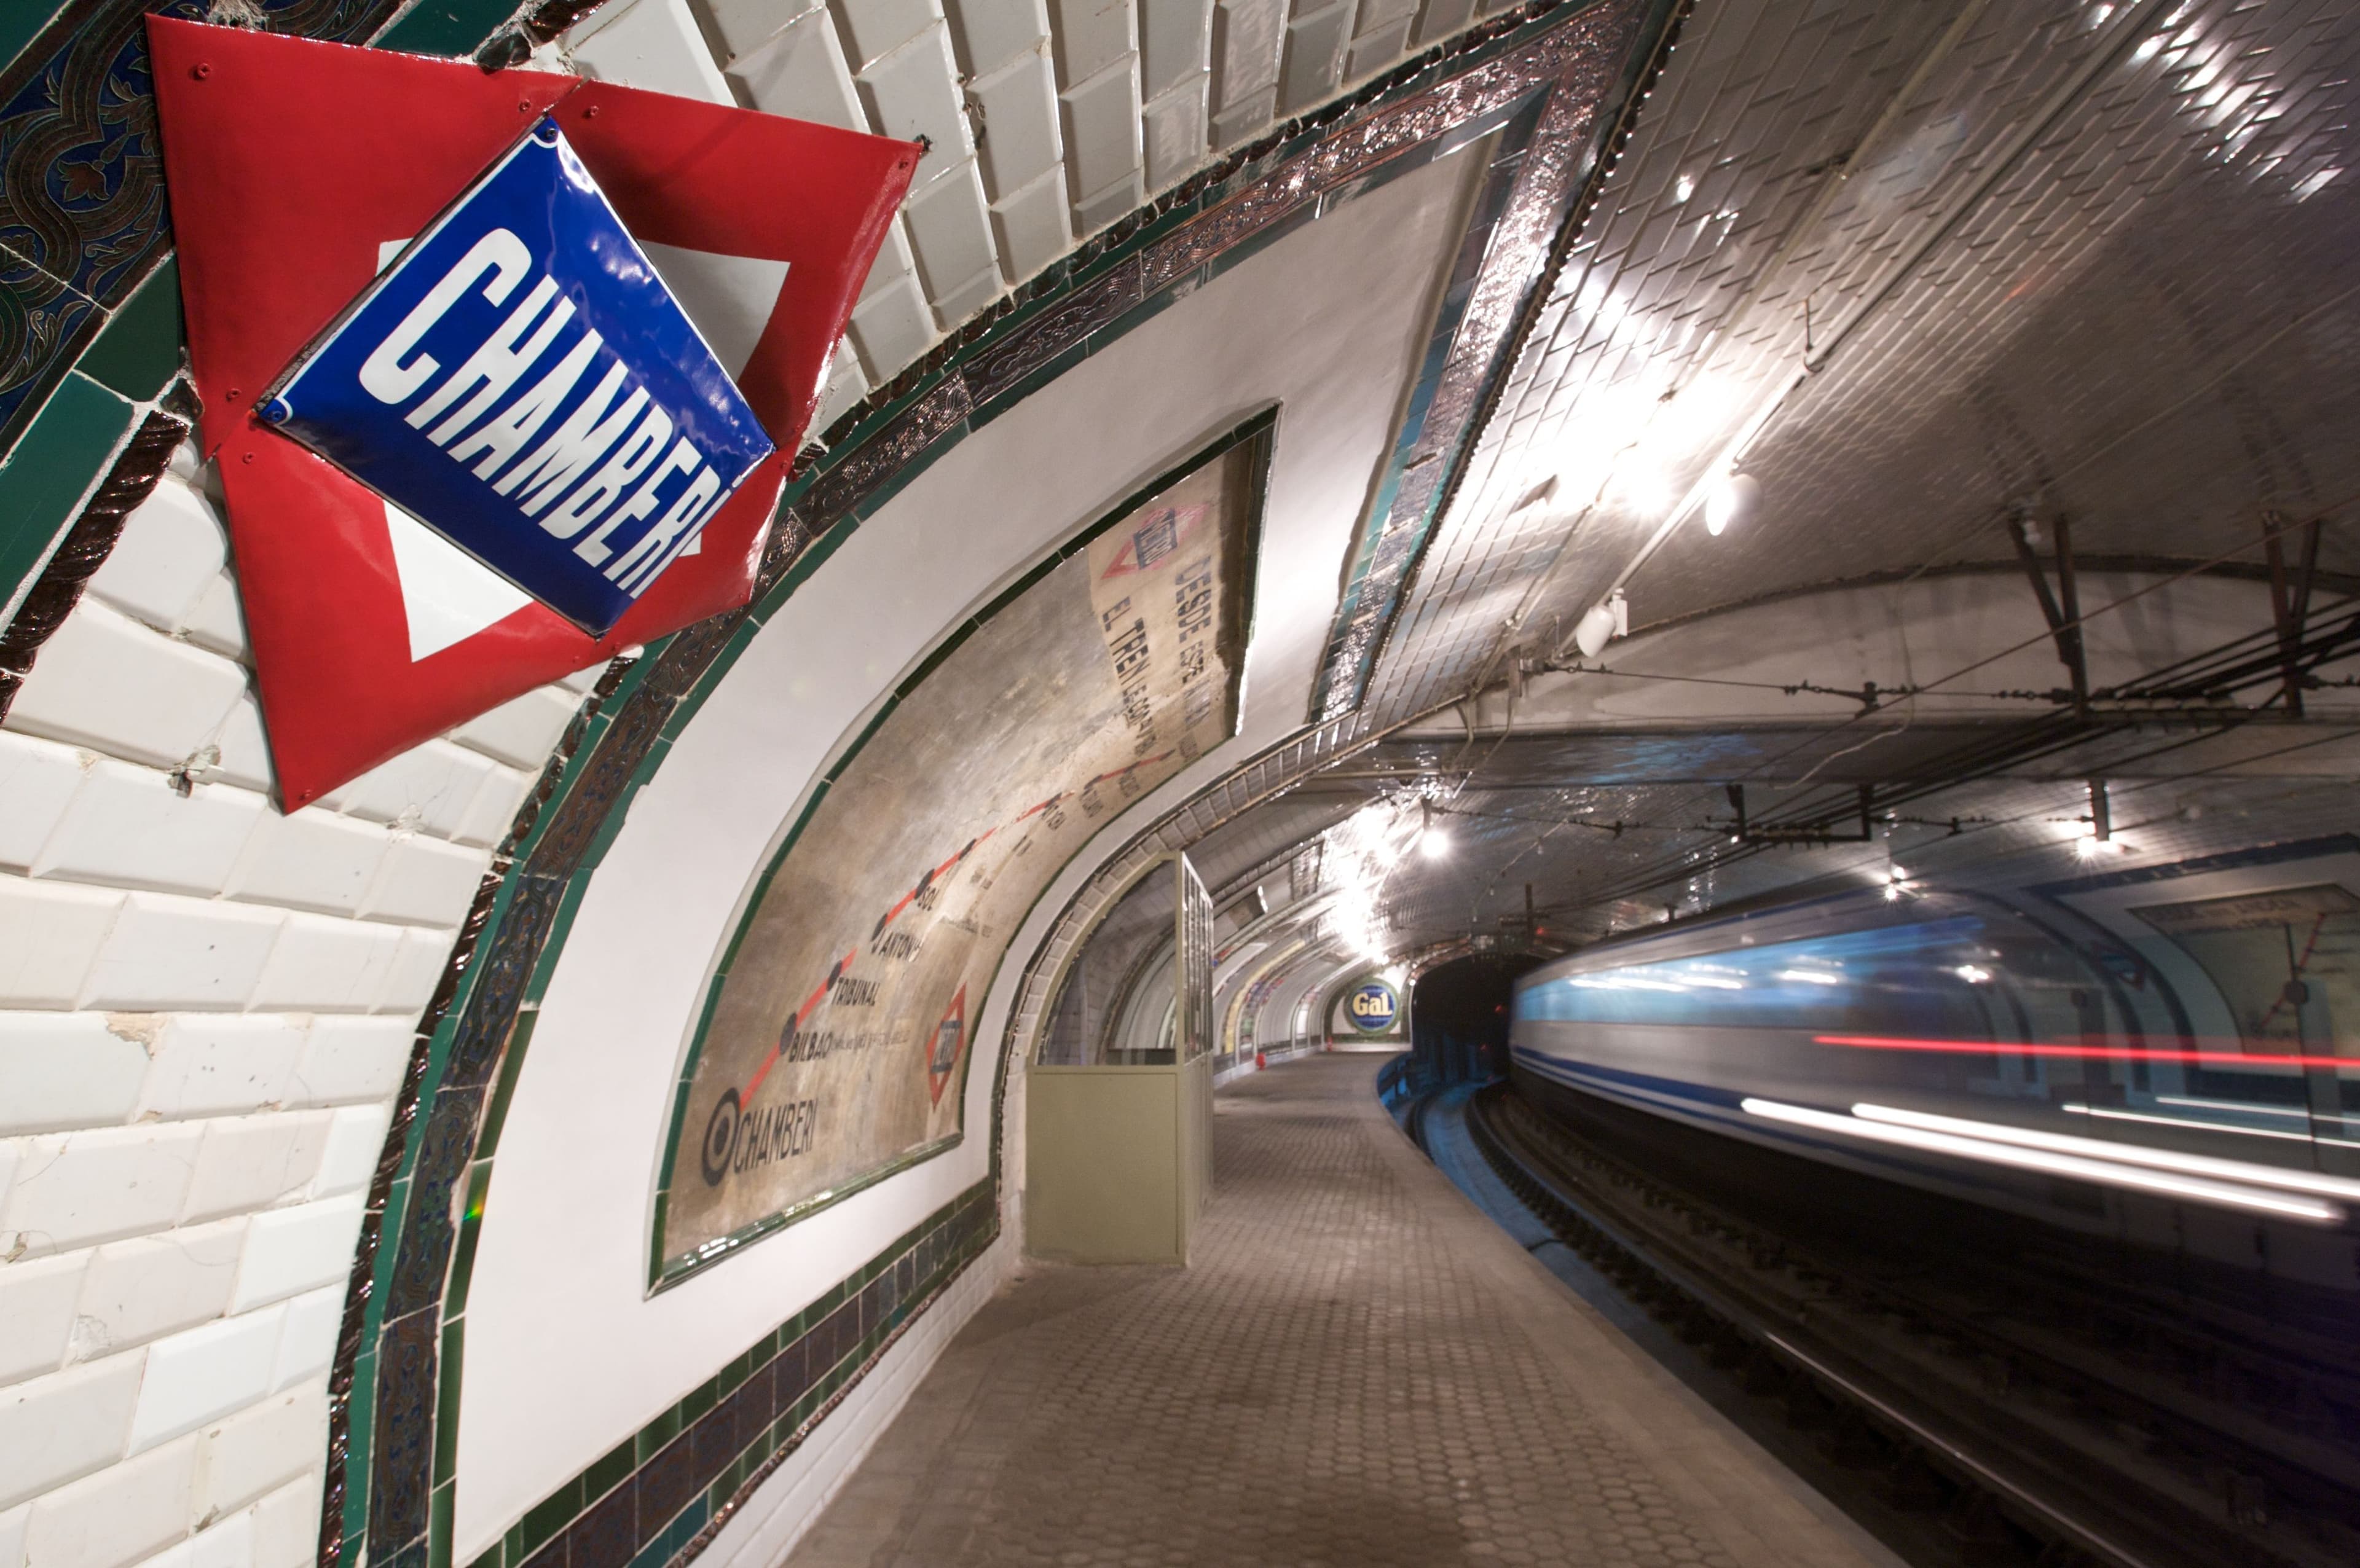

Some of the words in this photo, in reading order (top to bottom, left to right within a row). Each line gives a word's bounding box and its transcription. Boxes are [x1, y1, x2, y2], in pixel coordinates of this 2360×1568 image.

[359, 228, 731, 599] CHAMBERI
[1103, 596, 1131, 632] EL
[1175, 555, 1211, 643] DESDE
[1109, 617, 1150, 686] TREN
[918, 886, 940, 912] SOL
[1353, 992, 1393, 1016] Gal
[789, 1032, 833, 1063] BILBAO
[733, 1098, 819, 1175] CHAMBERI
